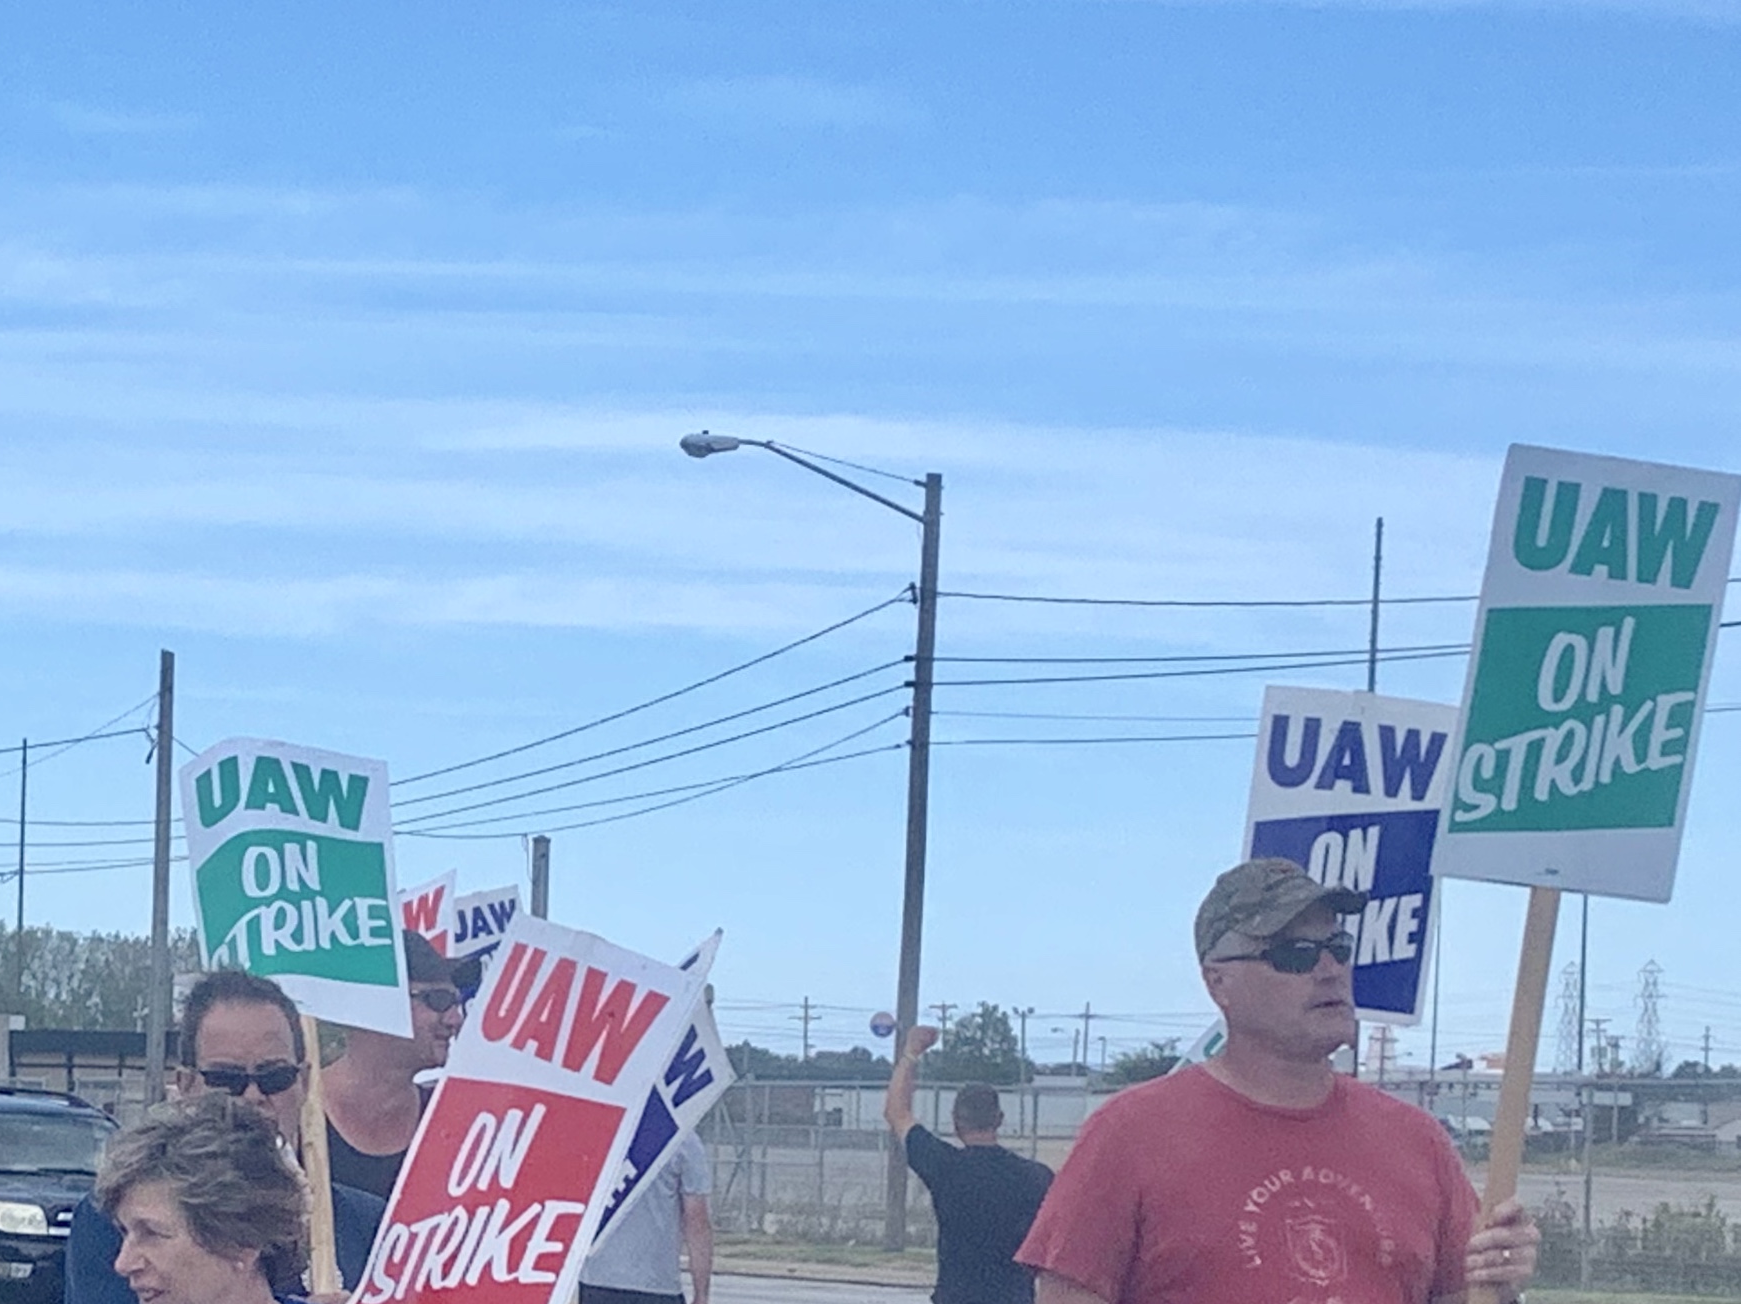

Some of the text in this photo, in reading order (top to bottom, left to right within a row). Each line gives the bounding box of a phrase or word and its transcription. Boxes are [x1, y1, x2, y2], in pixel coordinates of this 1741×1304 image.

[1512, 476, 1721, 590] UAW
[1538, 615, 1636, 713] ON
[195, 755, 370, 832] UAW
[1266, 714, 1449, 802] UAW
[1454, 691, 1696, 823] STRIKE
[241, 839, 322, 899] ON
[1307, 824, 1381, 892] ON
[1335, 892, 1424, 968] IKE
[479, 942, 671, 1086] UAW
[447, 1102, 546, 1198] ON
[1243, 1168, 1296, 1214] YOUR
